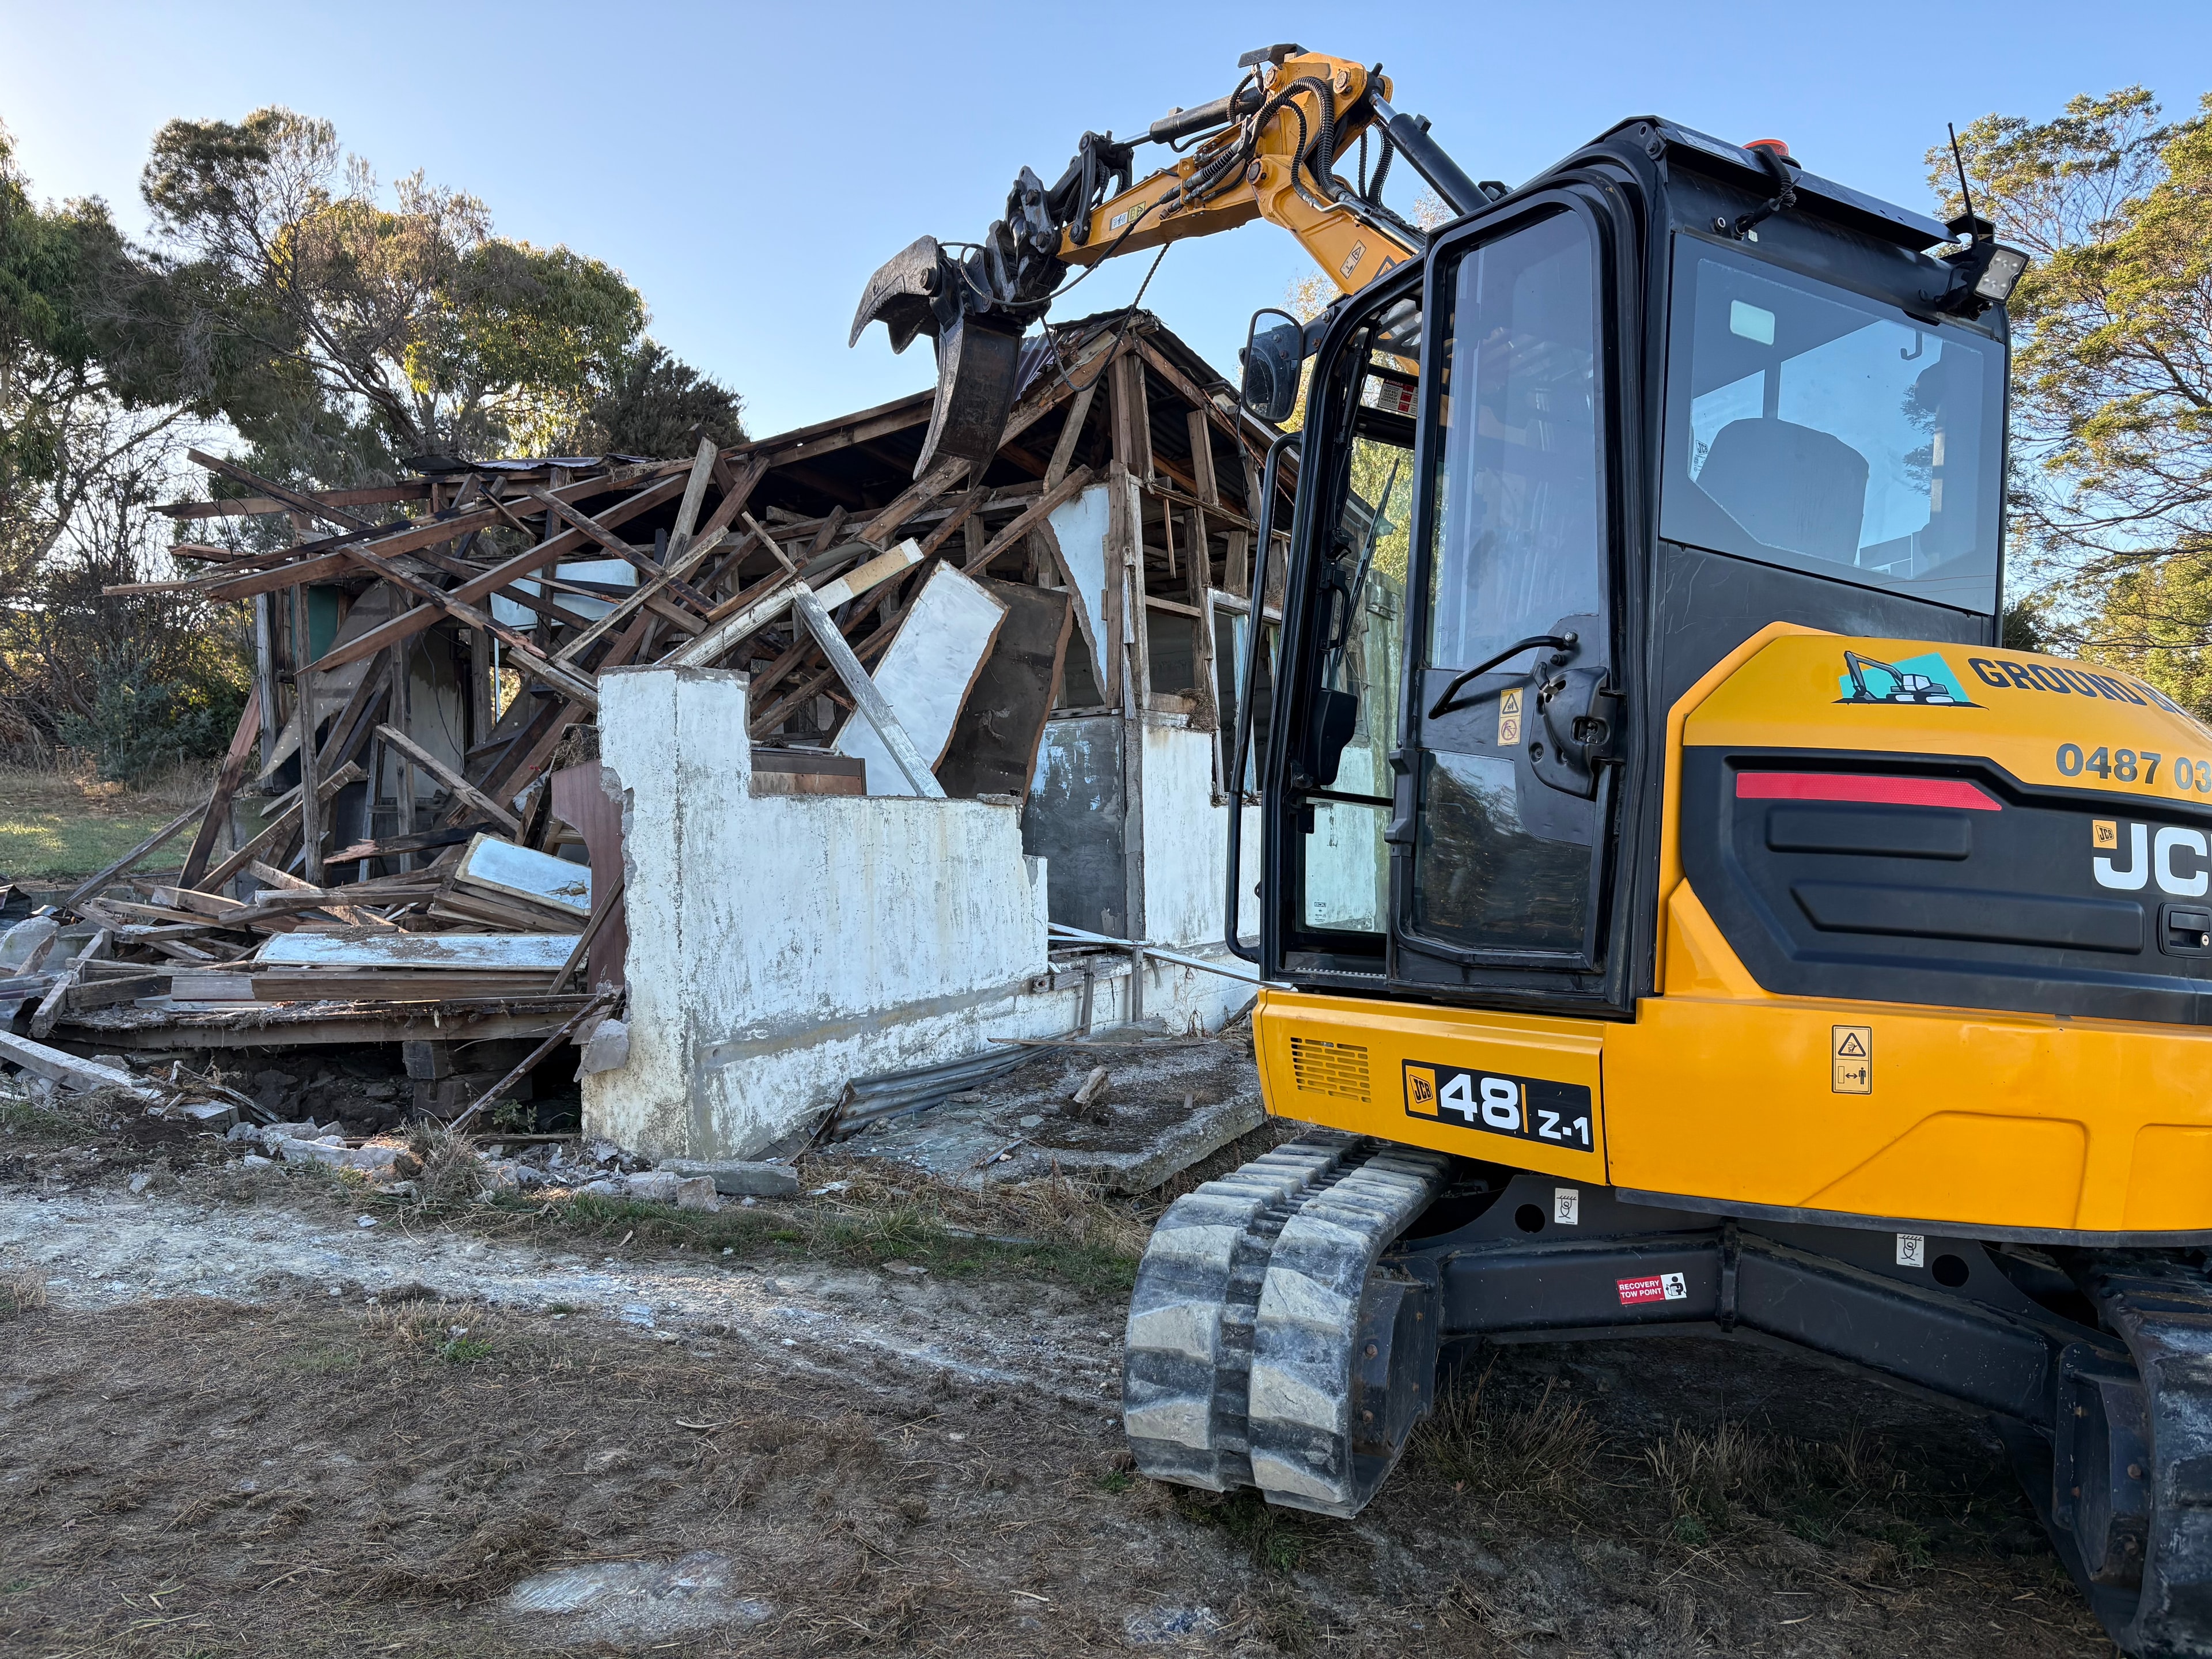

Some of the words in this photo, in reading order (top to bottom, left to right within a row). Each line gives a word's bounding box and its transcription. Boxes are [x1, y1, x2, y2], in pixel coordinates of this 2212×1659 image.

[1697, 441, 1708, 454] JCB
[1968, 658, 2147, 706] GROUND
[2056, 743, 2161, 784] 0487
[2174, 757, 2211, 793] 03
[2097, 826, 2113, 841] JCB
[2093, 823, 2212, 897] JC
[1412, 1077, 1433, 1101] JCB
[1440, 1073, 1520, 1130] 48
[1619, 1280, 1659, 1291] RECOVERY
[1620, 1290, 1637, 1298] TOW
[1639, 1288, 1662, 1296] POINT
